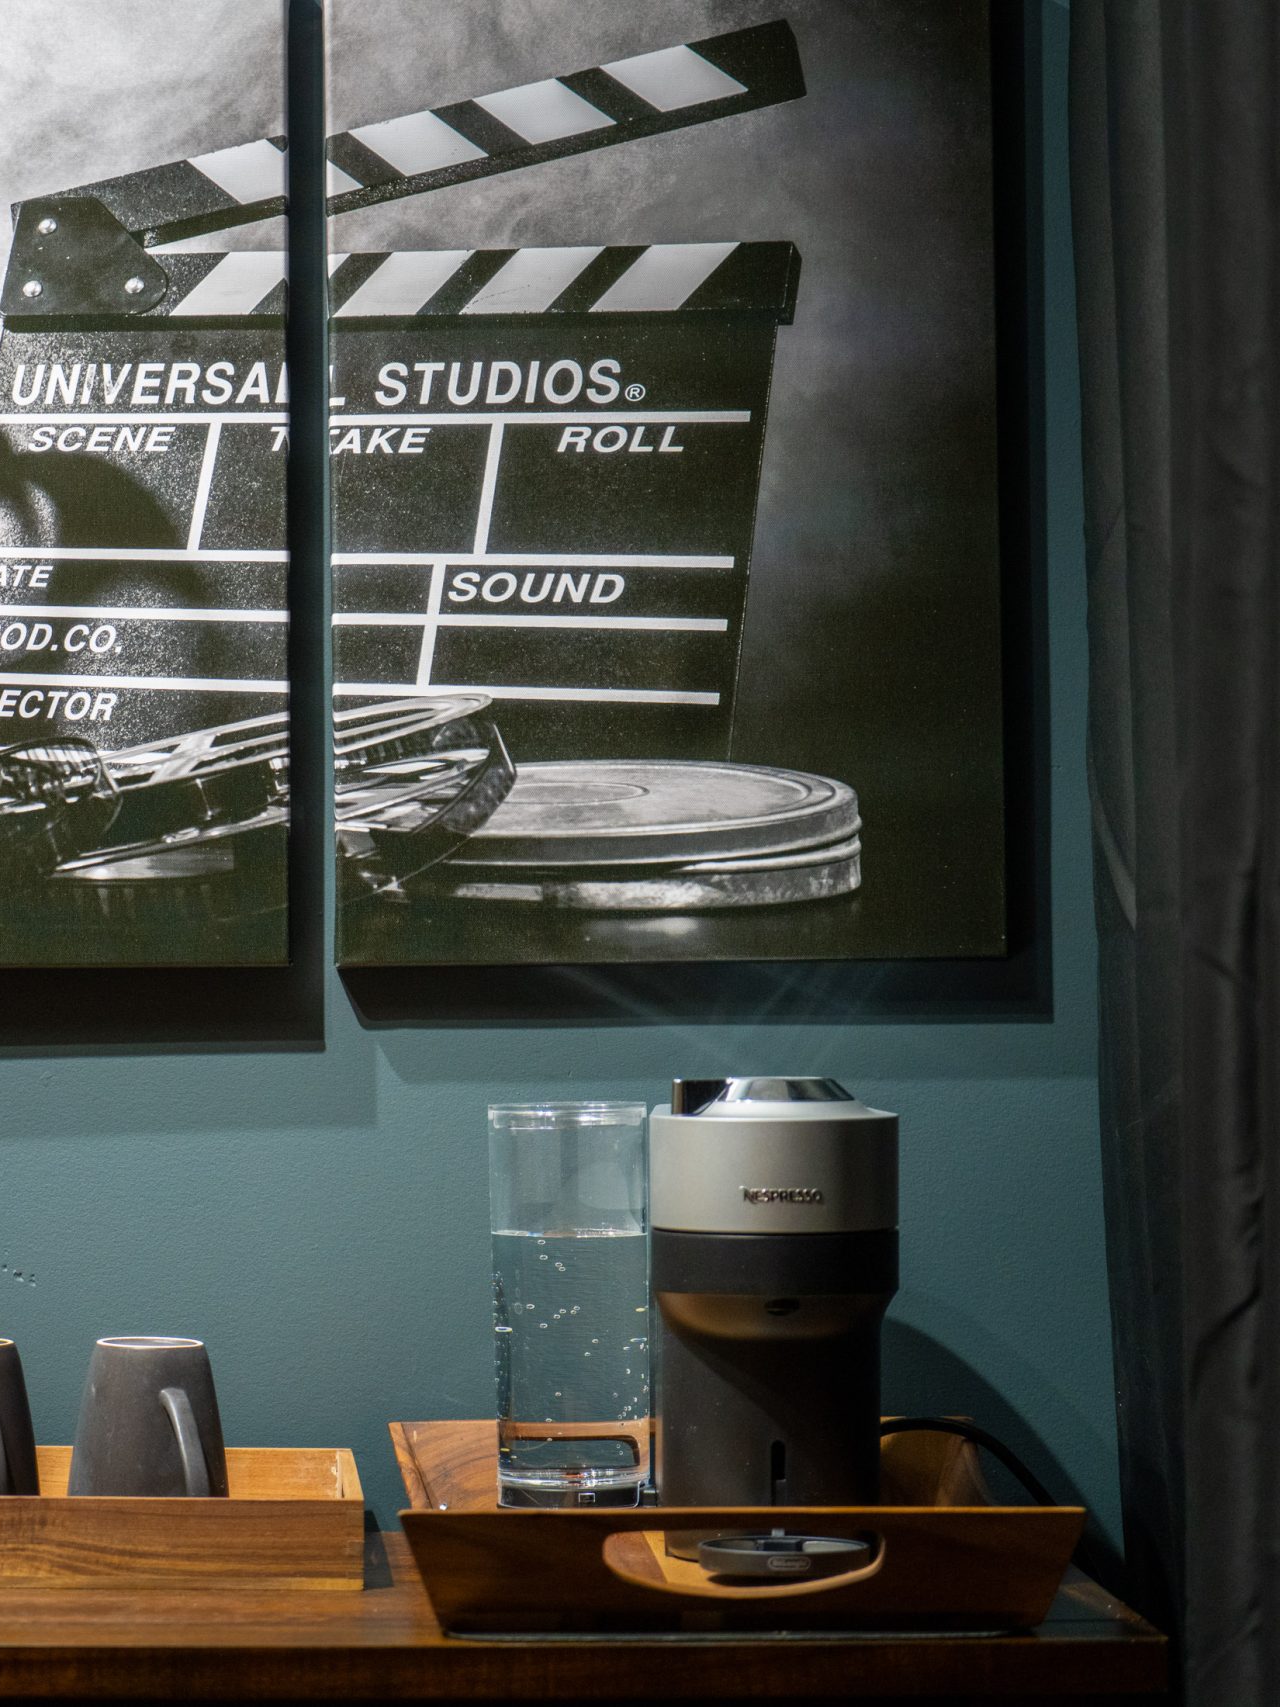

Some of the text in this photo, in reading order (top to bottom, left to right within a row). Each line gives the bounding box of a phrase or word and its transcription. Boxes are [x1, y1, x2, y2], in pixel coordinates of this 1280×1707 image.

[11, 361, 345, 406] UNIVERSAL
[27, 427, 176, 453] SCENE
[557, 425, 685, 453] ROLL
[448, 572, 626, 603] SOUND
[741, 1186, 823, 1204] NESPRESSO
